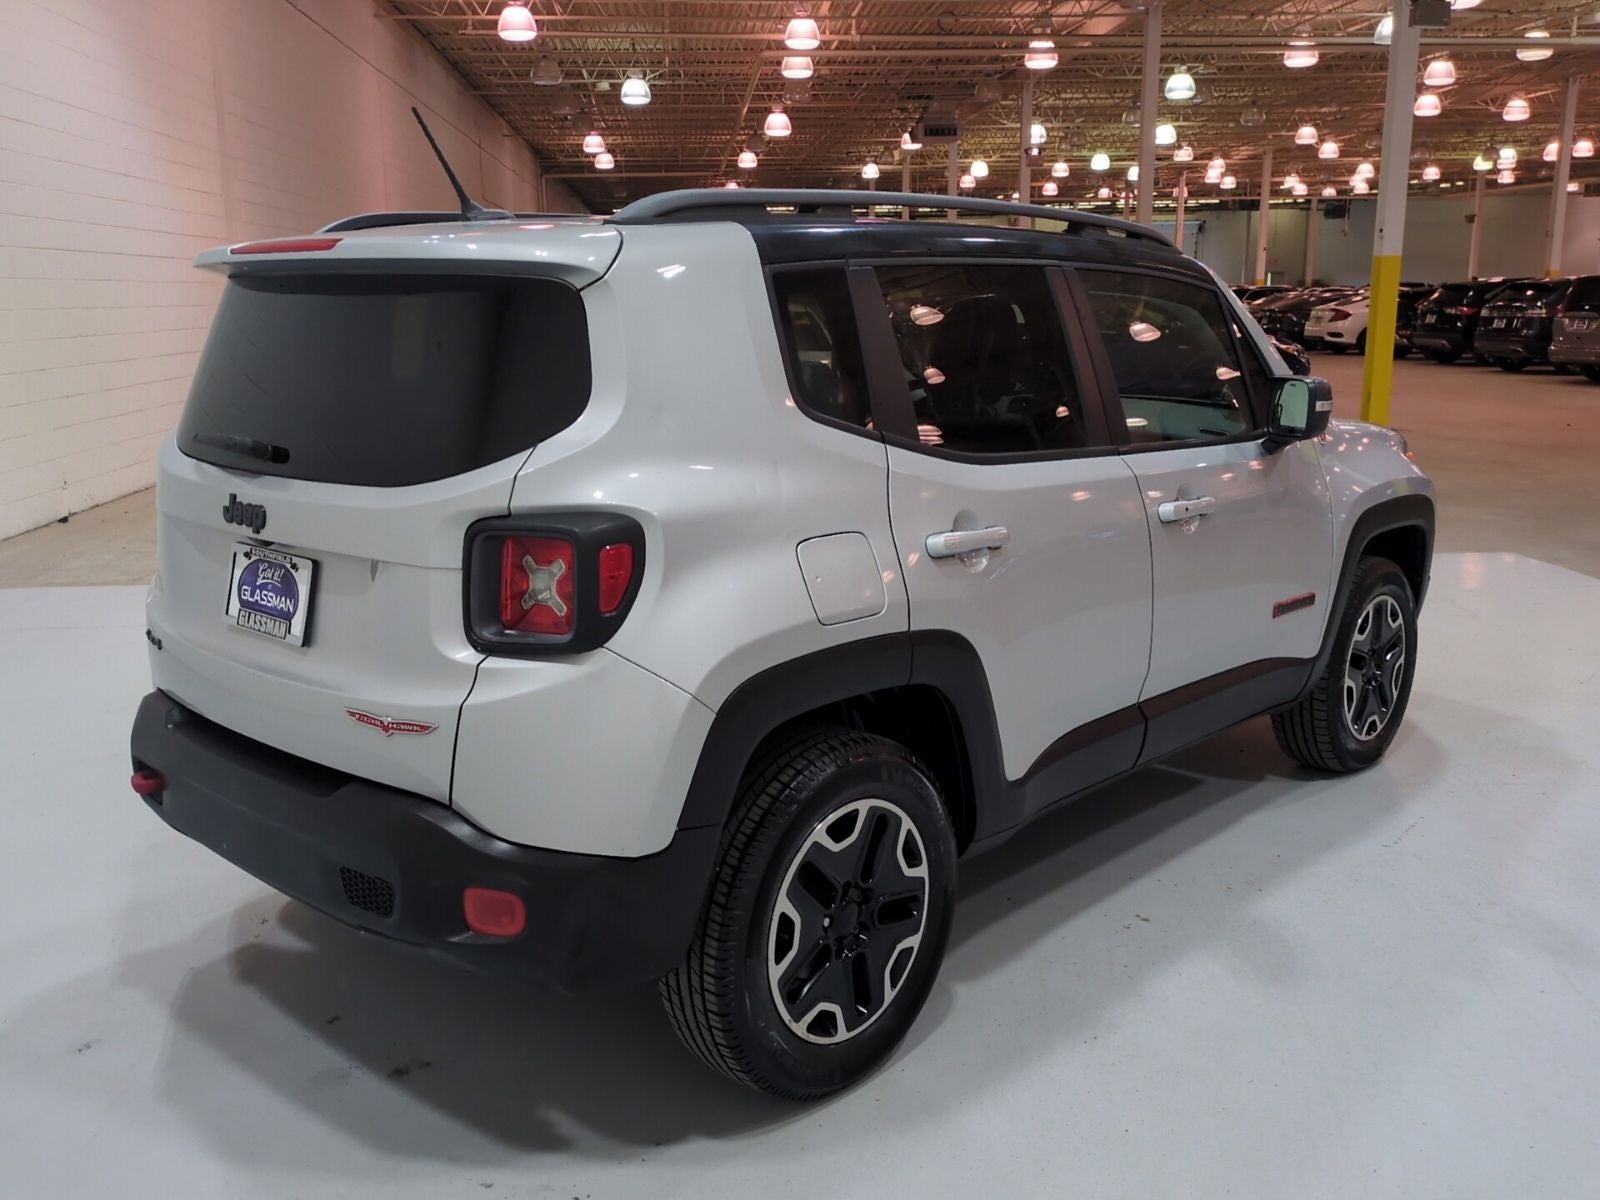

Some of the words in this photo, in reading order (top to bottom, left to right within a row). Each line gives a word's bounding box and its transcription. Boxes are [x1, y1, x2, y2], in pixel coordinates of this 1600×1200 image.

[222, 493, 267, 534] Jeep
[258, 562, 274, 581] Got
[241, 585, 295, 613] GLASSMAN
[238, 610, 287, 638] GLASSMAN
